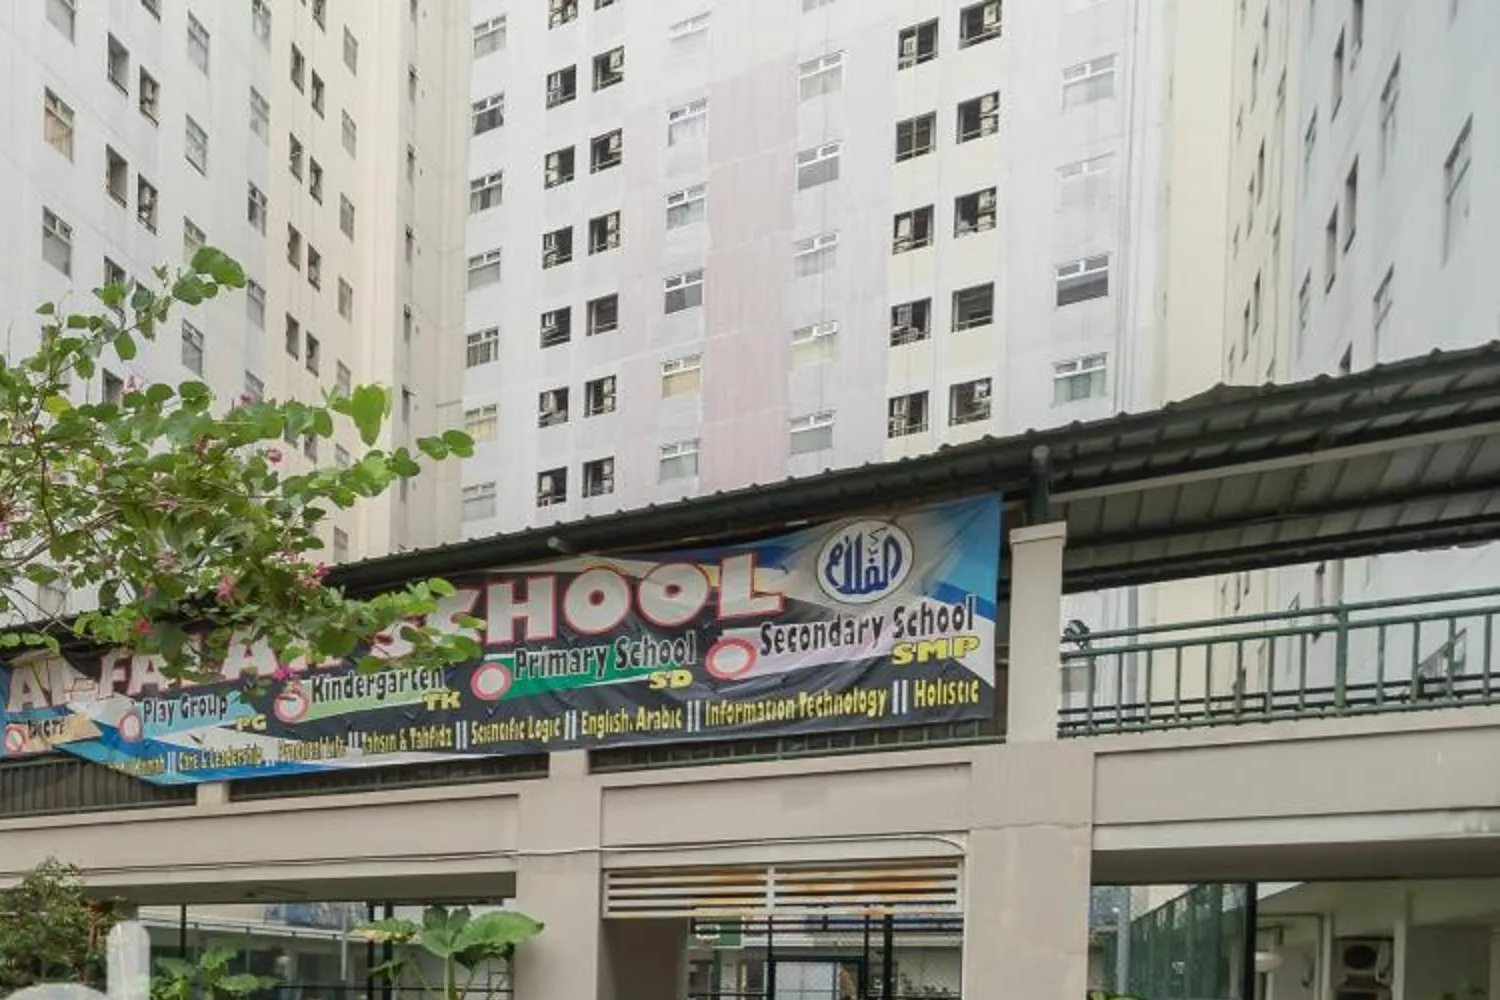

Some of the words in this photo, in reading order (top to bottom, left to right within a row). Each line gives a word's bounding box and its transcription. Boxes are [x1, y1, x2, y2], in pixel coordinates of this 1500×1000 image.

[760, 614, 885, 656] Secondary
[893, 594, 976, 638] School
[514, 645, 609, 680] Primary
[615, 630, 697, 671] School
[891, 635, 980, 665] SMP
[312, 667, 447, 702] Kindergarten
[914, 679, 980, 707] Holistic
[143, 697, 176, 727] Play
[180, 694, 229, 720] Group
[635, 704, 682, 730] Arabic
[799, 687, 888, 717] Technology
